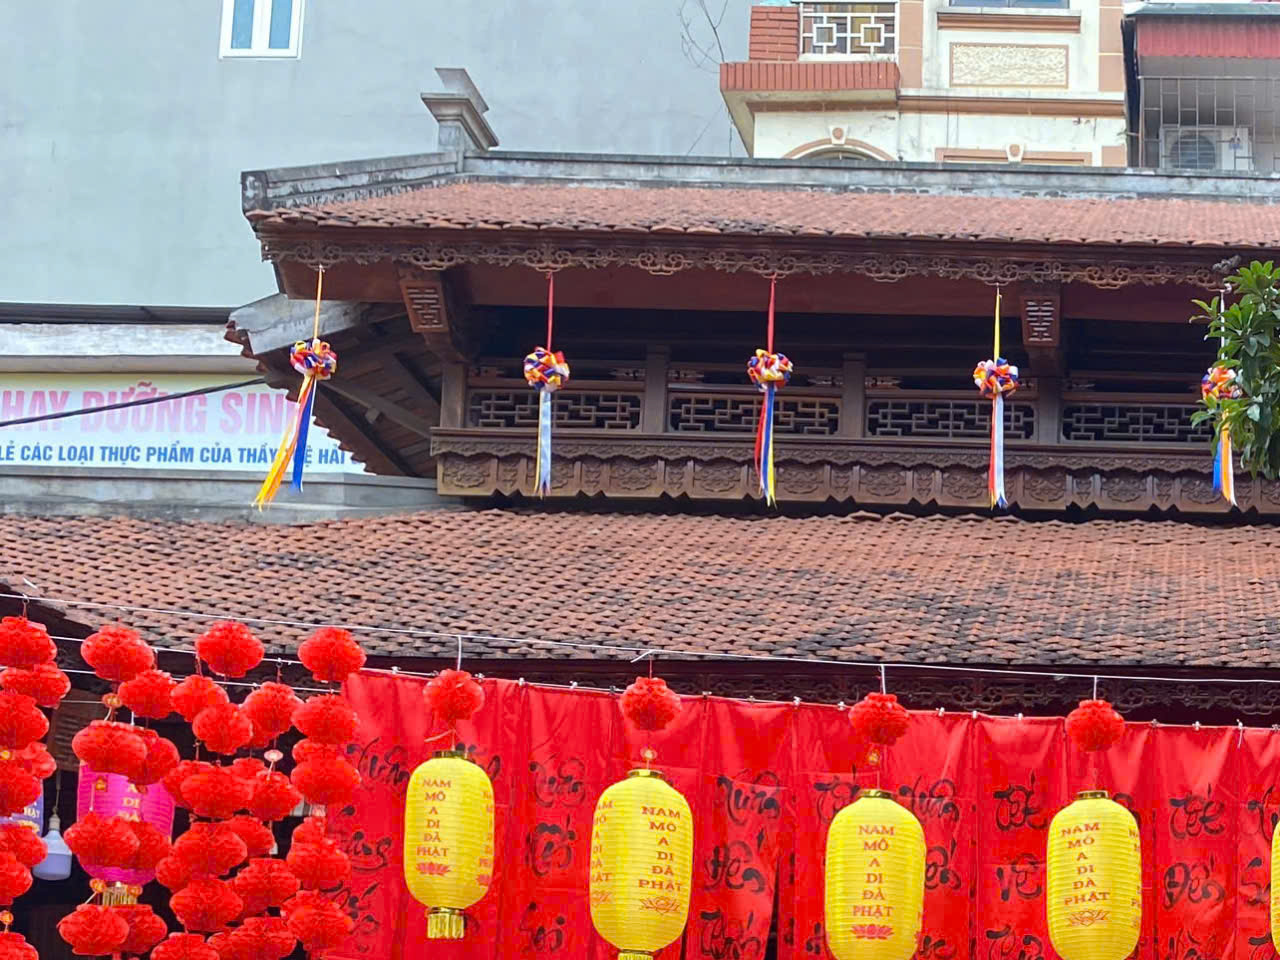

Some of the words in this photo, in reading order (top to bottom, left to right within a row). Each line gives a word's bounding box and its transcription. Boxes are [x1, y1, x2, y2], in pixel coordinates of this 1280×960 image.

[20, 441, 53, 462] CÁC
[58, 445, 94, 465] LOẠI
[100, 445, 140, 465] THỰC
[146, 440, 194, 463] PHẨM
[200, 441, 232, 463] CỦA
[423, 778, 452, 789] NAM
[123, 796, 141, 808] DI
[428, 806, 439, 815] A
[640, 805, 681, 819] NAM
[426, 819, 441, 829] DI
[1061, 822, 1101, 837] NAM
[858, 825, 895, 837] NAM
[658, 837, 669, 847] A
[655, 851, 675, 861] DI
[1076, 852, 1089, 861] A
[869, 858, 881, 867] A
[1076, 865, 1095, 876] DI
[866, 873, 884, 884] DI
